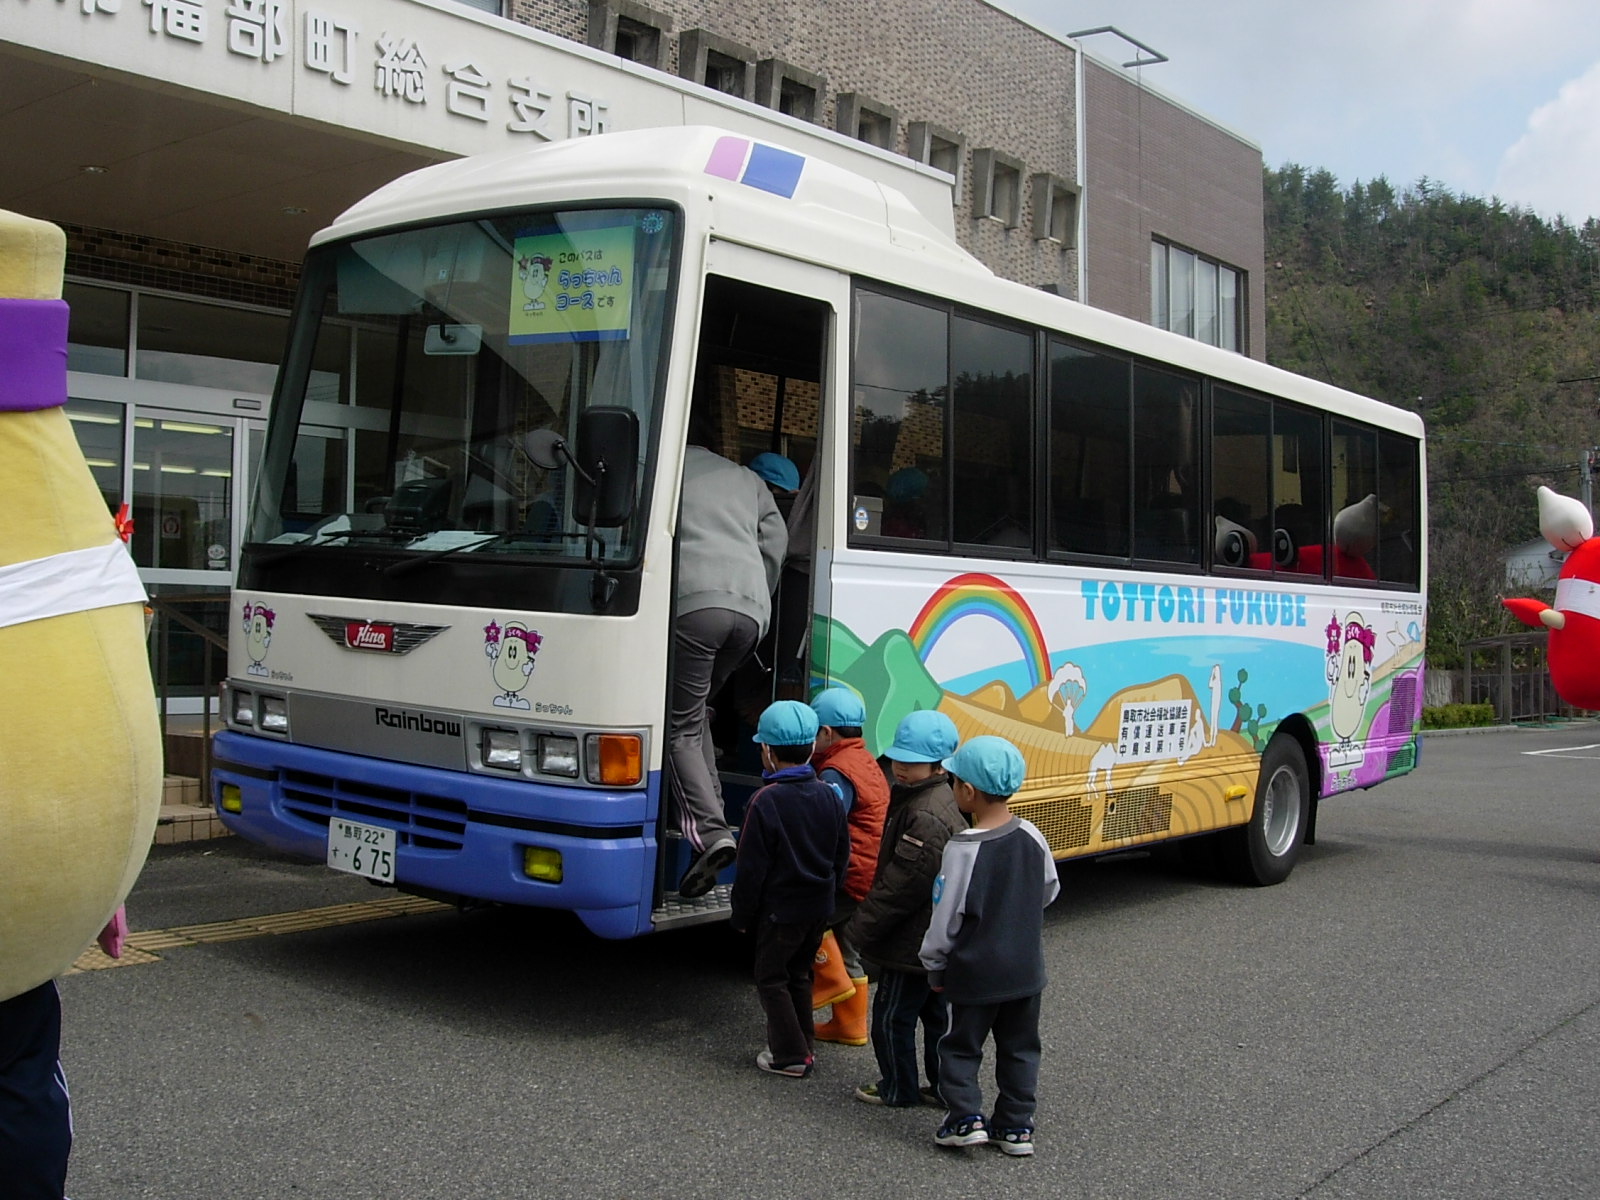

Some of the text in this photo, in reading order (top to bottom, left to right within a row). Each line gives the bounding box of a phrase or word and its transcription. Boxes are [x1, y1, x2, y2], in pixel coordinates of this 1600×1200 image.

[559, 250, 603, 264] このバスは
[558, 266, 622, 289] らっちゃん
[1081, 579, 1307, 627] TOTTORI FUKUBE
[353, 625, 386, 648] Hino
[375, 707, 460, 737] Rainbow
